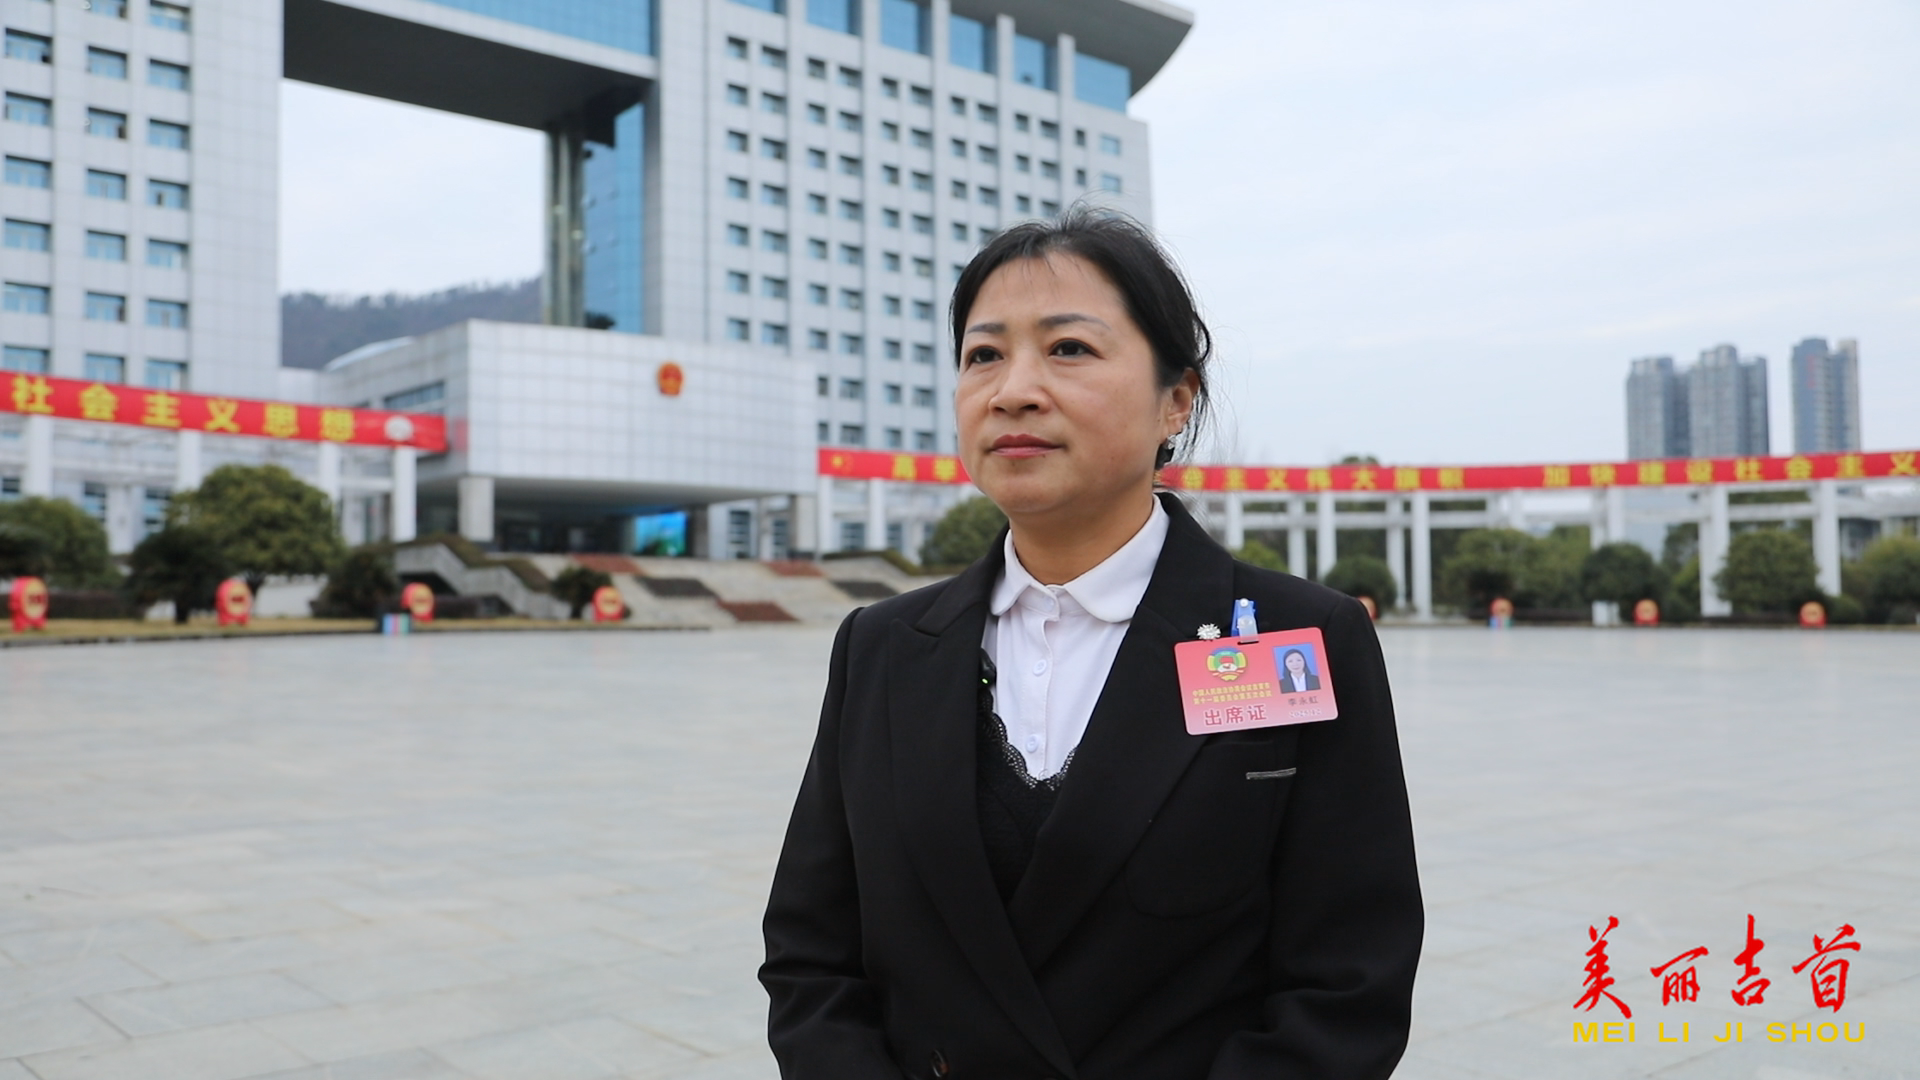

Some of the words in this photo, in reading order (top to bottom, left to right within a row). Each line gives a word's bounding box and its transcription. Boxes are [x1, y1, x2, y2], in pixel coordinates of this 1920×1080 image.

[10, 374, 356, 443] 社会主义思想
[1204, 704, 1267, 726] 出席证
